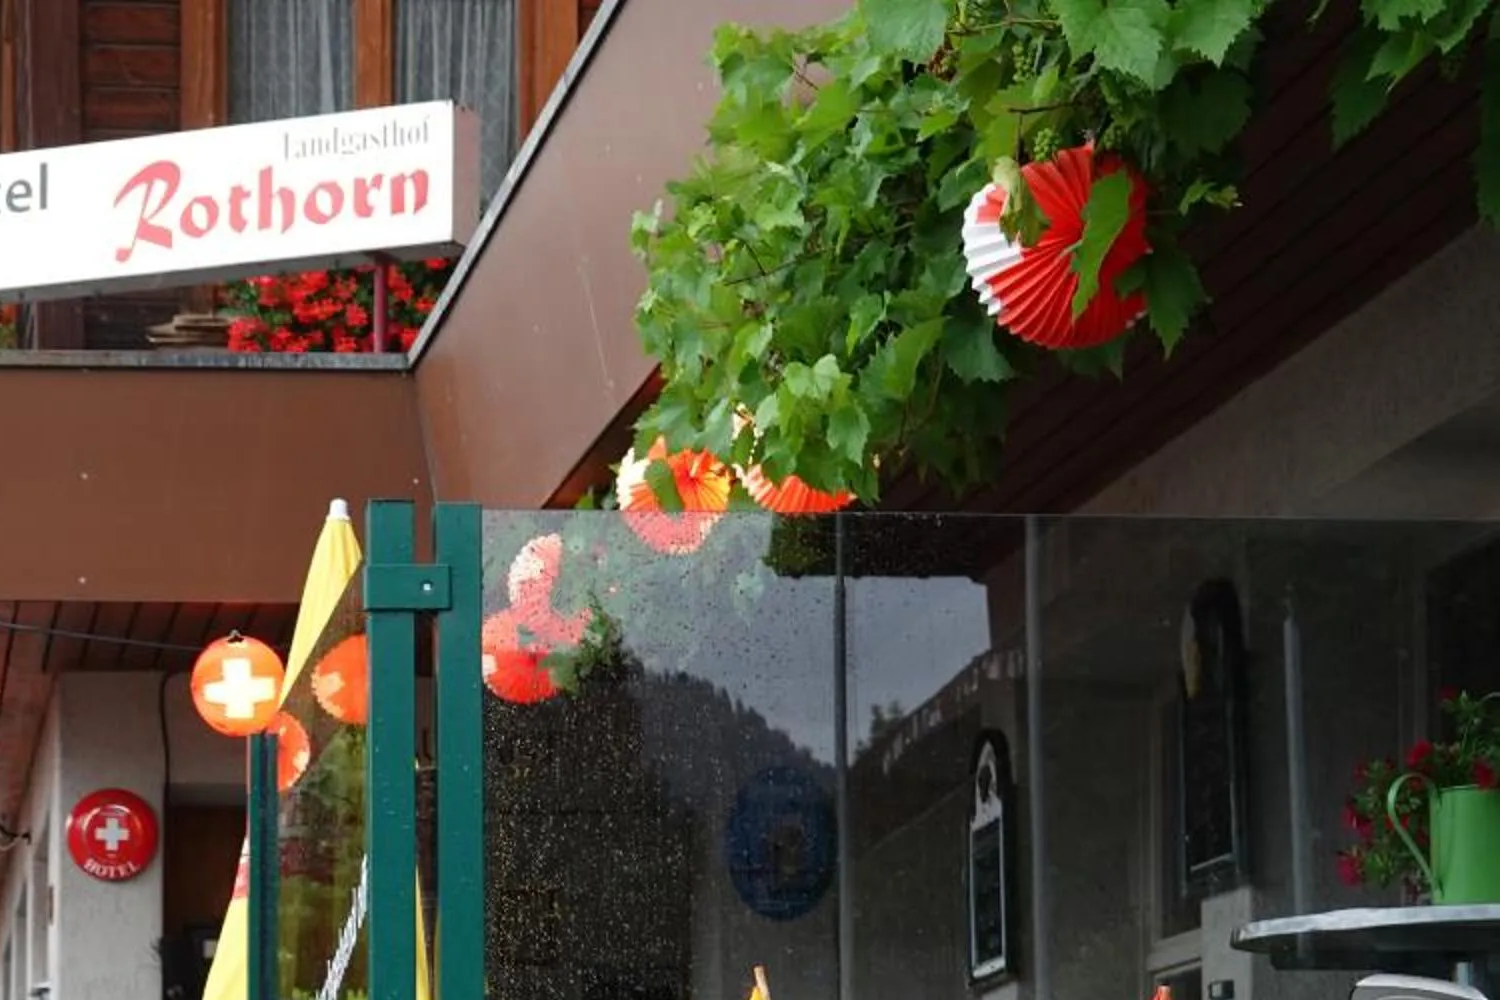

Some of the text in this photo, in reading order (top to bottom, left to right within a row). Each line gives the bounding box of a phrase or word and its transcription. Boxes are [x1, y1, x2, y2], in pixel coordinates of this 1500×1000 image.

[281, 114, 431, 162] Landgasthof
[113, 158, 431, 264] Rothorn
[83, 858, 138, 879] HOTEL
